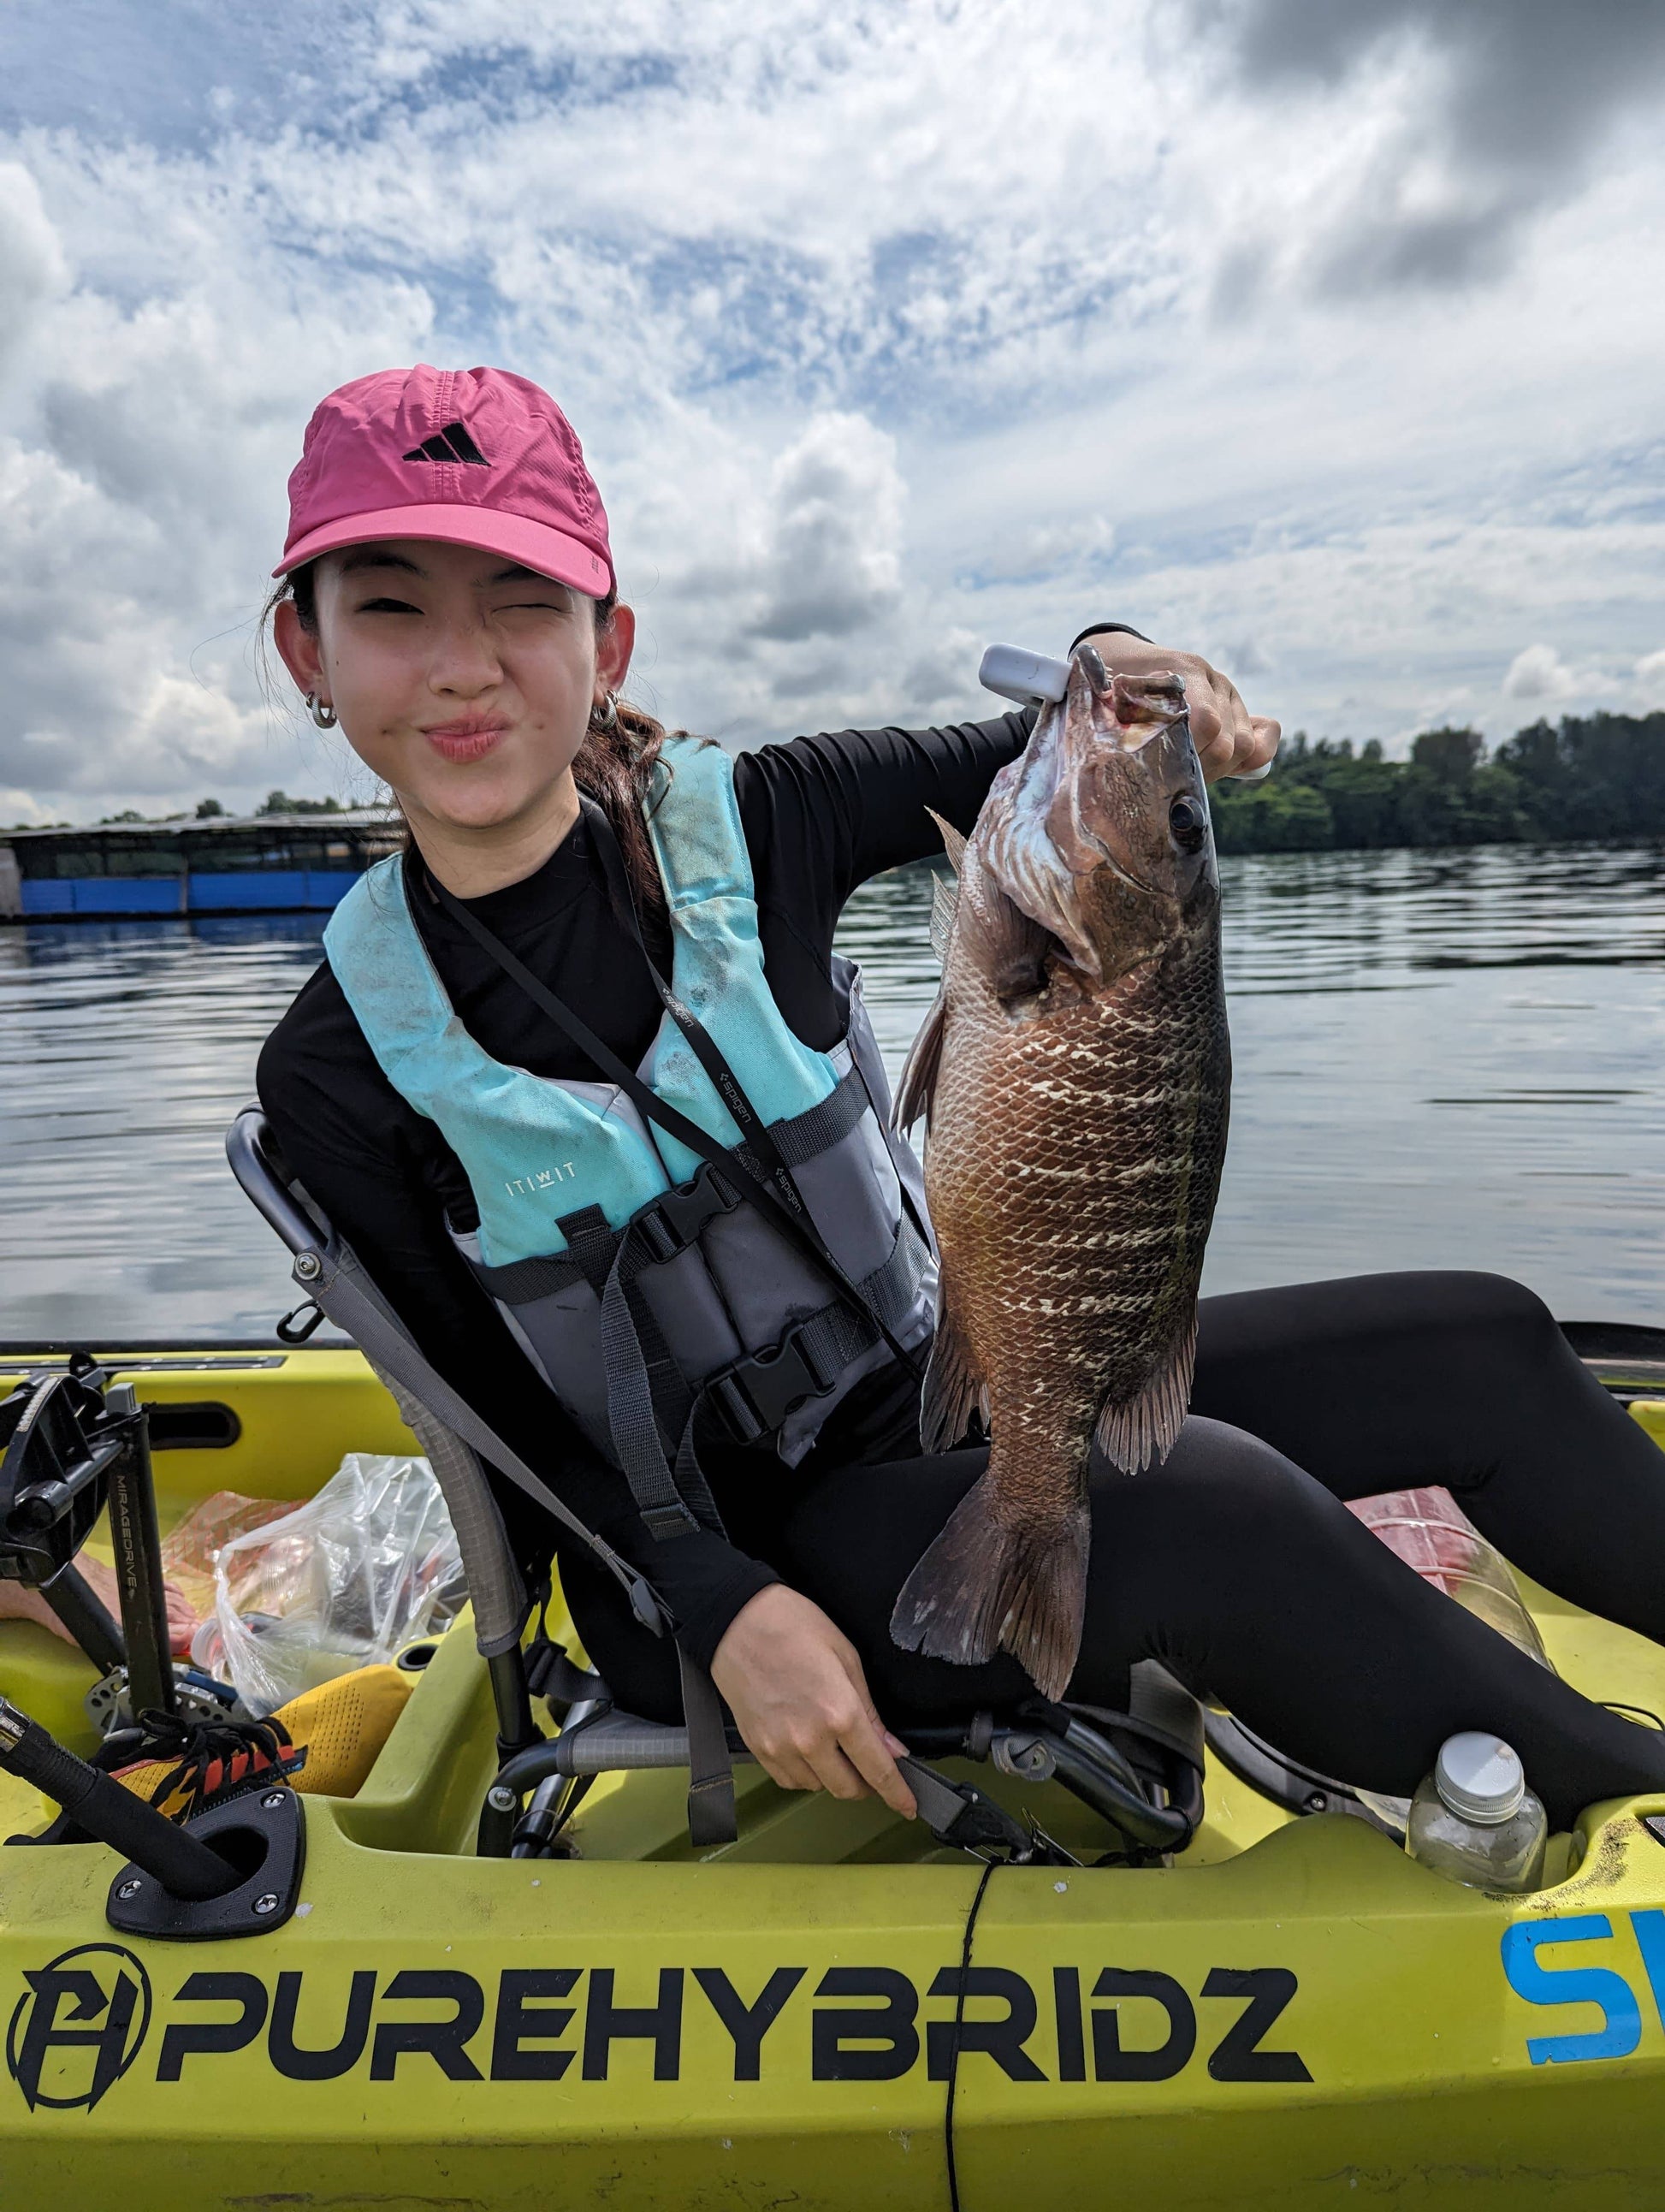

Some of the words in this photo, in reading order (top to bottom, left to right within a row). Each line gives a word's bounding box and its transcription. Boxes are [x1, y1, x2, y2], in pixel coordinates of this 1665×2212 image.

[666, 995, 695, 1028] spigen
[722, 1081, 752, 1124] spigen
[505, 1161, 576, 1197] ITIWIT
[778, 1176, 802, 1213] spigen
[116, 1474, 138, 1589] MIRAGEDRIVE
[156, 1966, 1314, 2082] PUREHYBRIDZ
